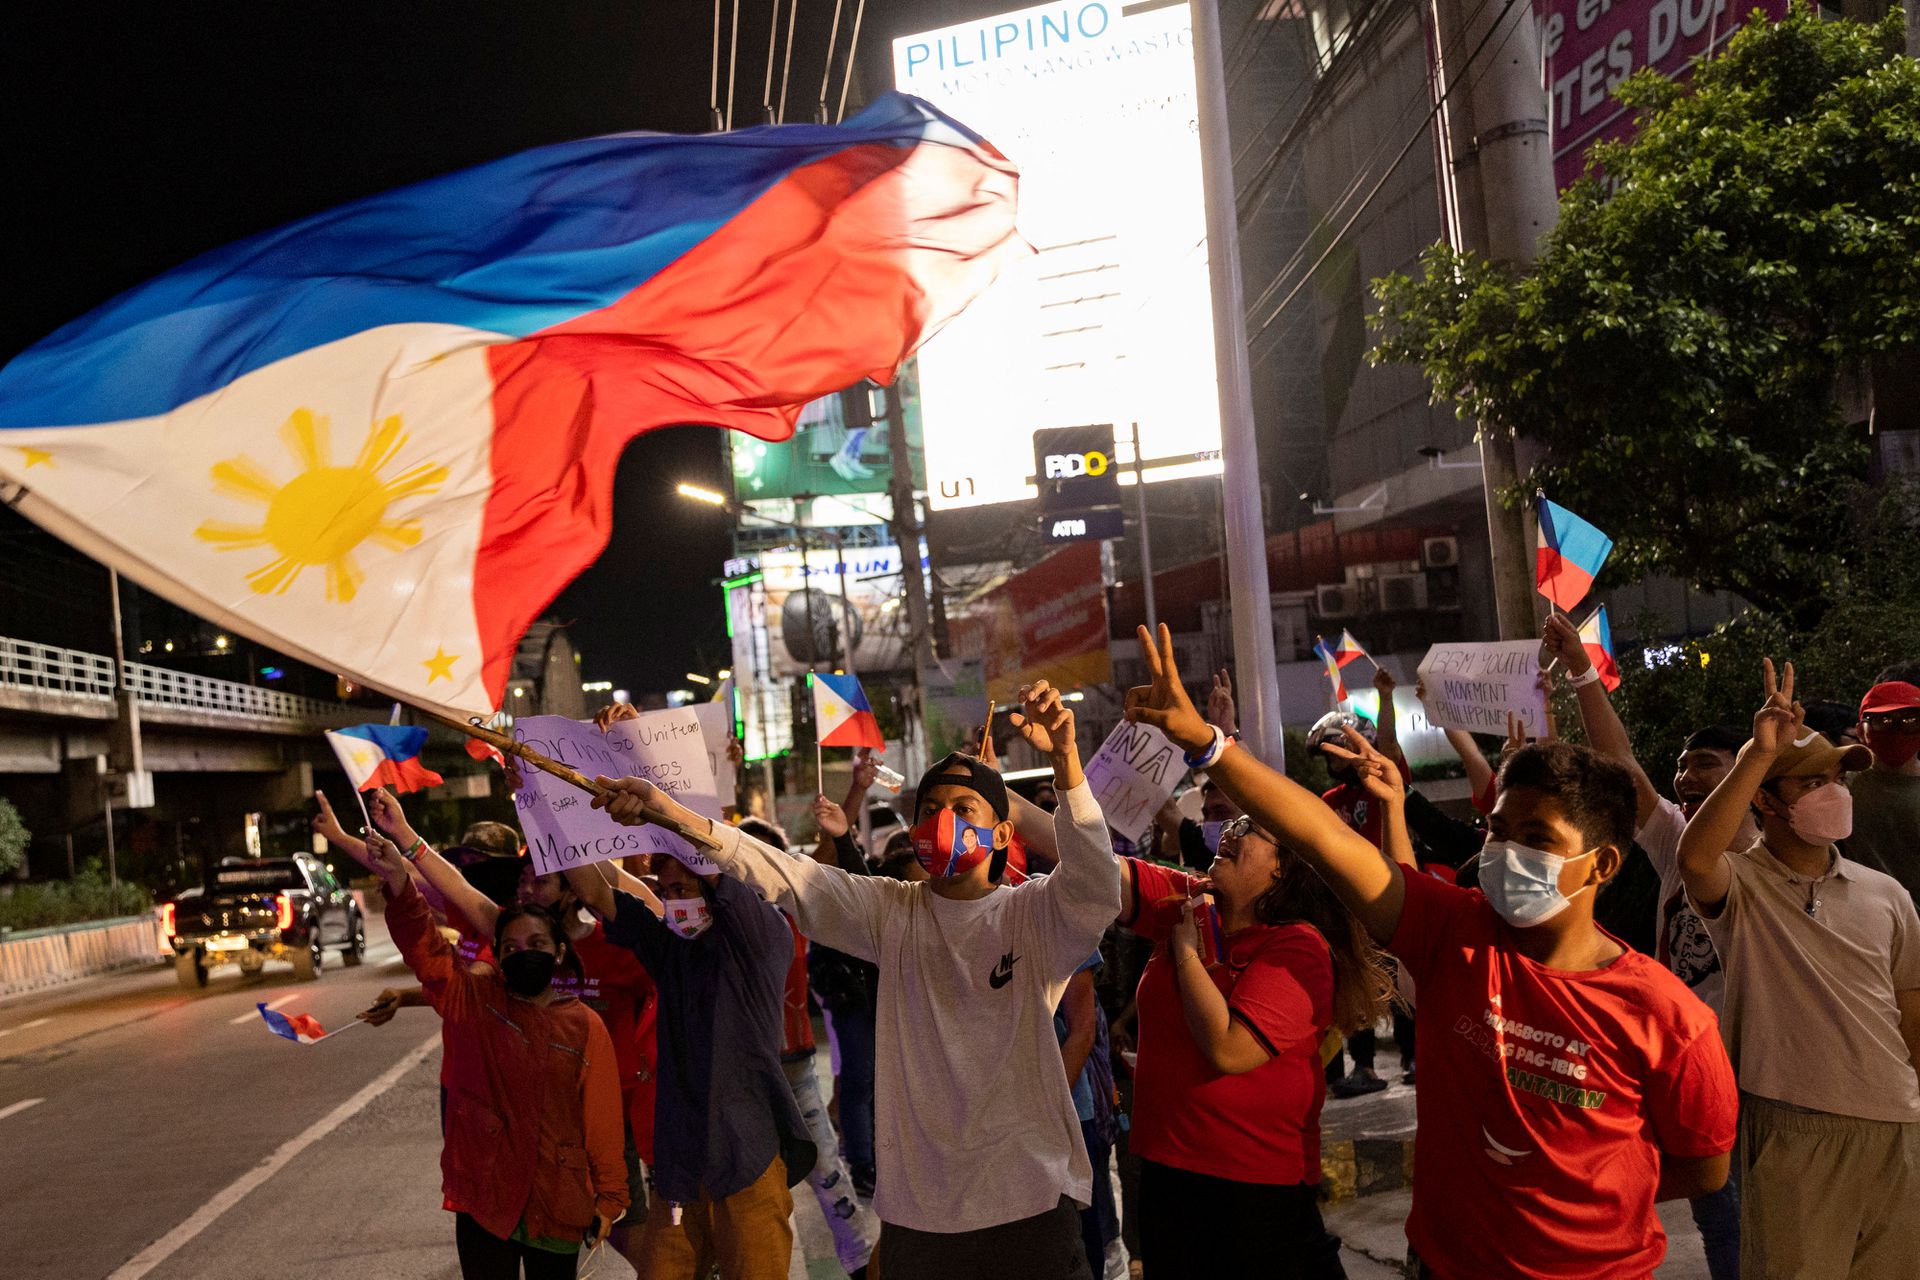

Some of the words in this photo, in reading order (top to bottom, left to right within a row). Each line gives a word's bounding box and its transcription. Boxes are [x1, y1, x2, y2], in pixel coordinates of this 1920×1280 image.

[906, 2, 1109, 78] PILIPINO
[1052, 520, 1086, 537] ATM
[1481, 651, 1530, 675] YOUTH
[1444, 680, 1510, 703] MOVEMENT
[605, 730, 635, 752] Go
[630, 760, 683, 779] MARCOS
[535, 830, 640, 873] Marcos
[1566, 1039, 1592, 1057] AY
[1515, 1046, 1588, 1081] PAG-IBIG
